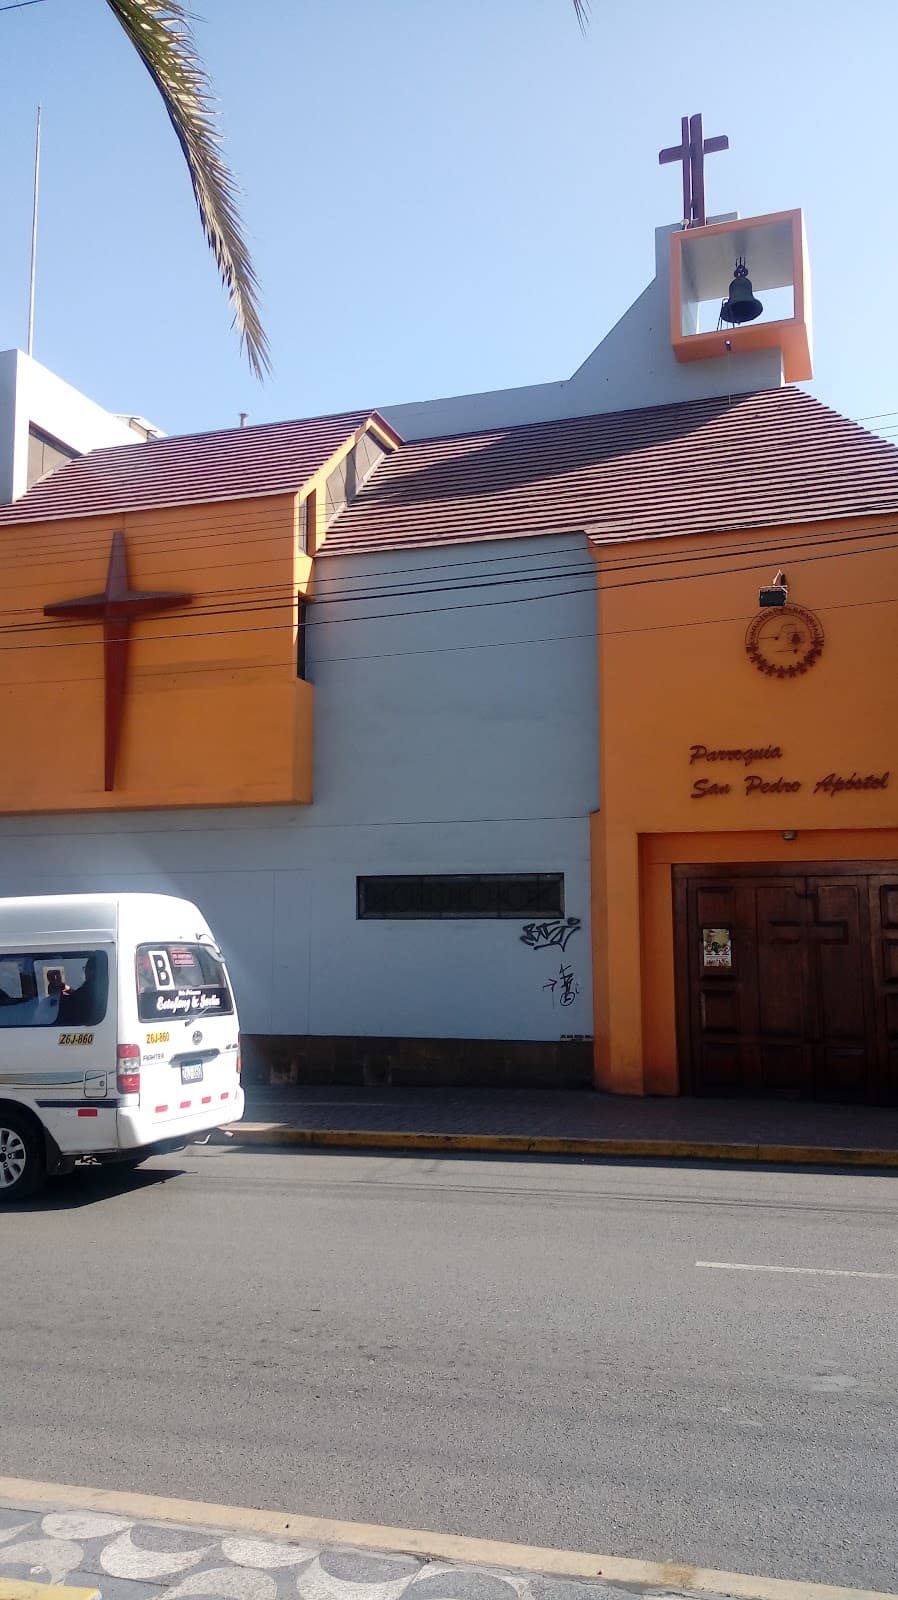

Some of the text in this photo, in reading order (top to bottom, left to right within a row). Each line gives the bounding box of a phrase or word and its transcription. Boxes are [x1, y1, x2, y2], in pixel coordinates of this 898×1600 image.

[689, 744, 784, 767] Parroquia
[690, 771, 890, 799] San Pedro Apóstol
[152, 954, 171, 986] B
[59, 1033, 94, 1045] Z6J-860
[146, 1032, 170, 1044] Z6J-860
